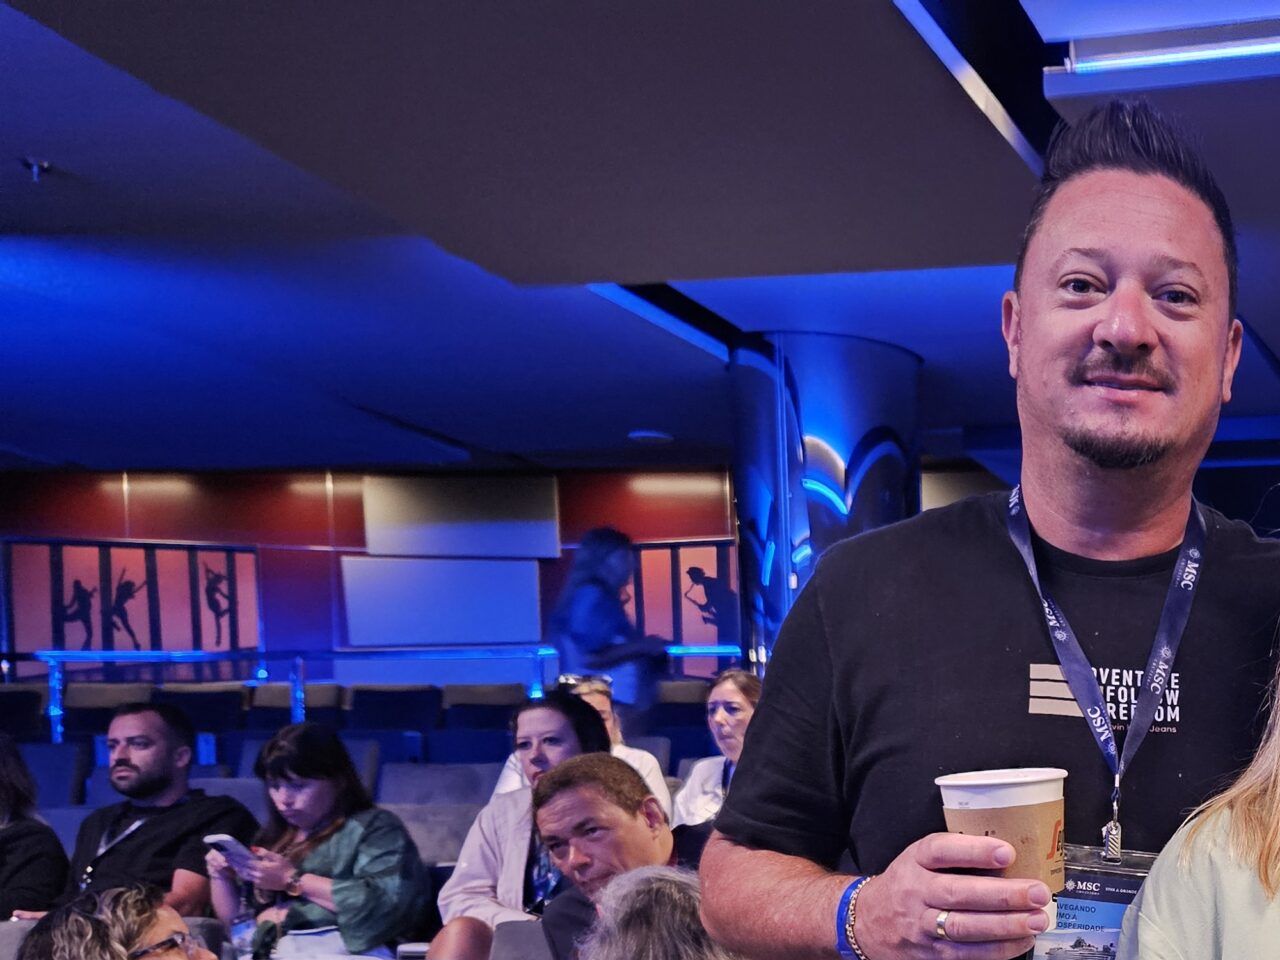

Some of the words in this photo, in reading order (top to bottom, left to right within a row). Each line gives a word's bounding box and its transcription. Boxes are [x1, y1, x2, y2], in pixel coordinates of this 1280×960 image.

[1180, 560, 1200, 591] MSC
[1150, 660, 1169, 695] MSC
[1087, 705, 1112, 742] MSC
[1149, 725, 1177, 733] Jeans
[1076, 881, 1101, 892] MSC
[1057, 921, 1105, 933] OSPERIDADE
